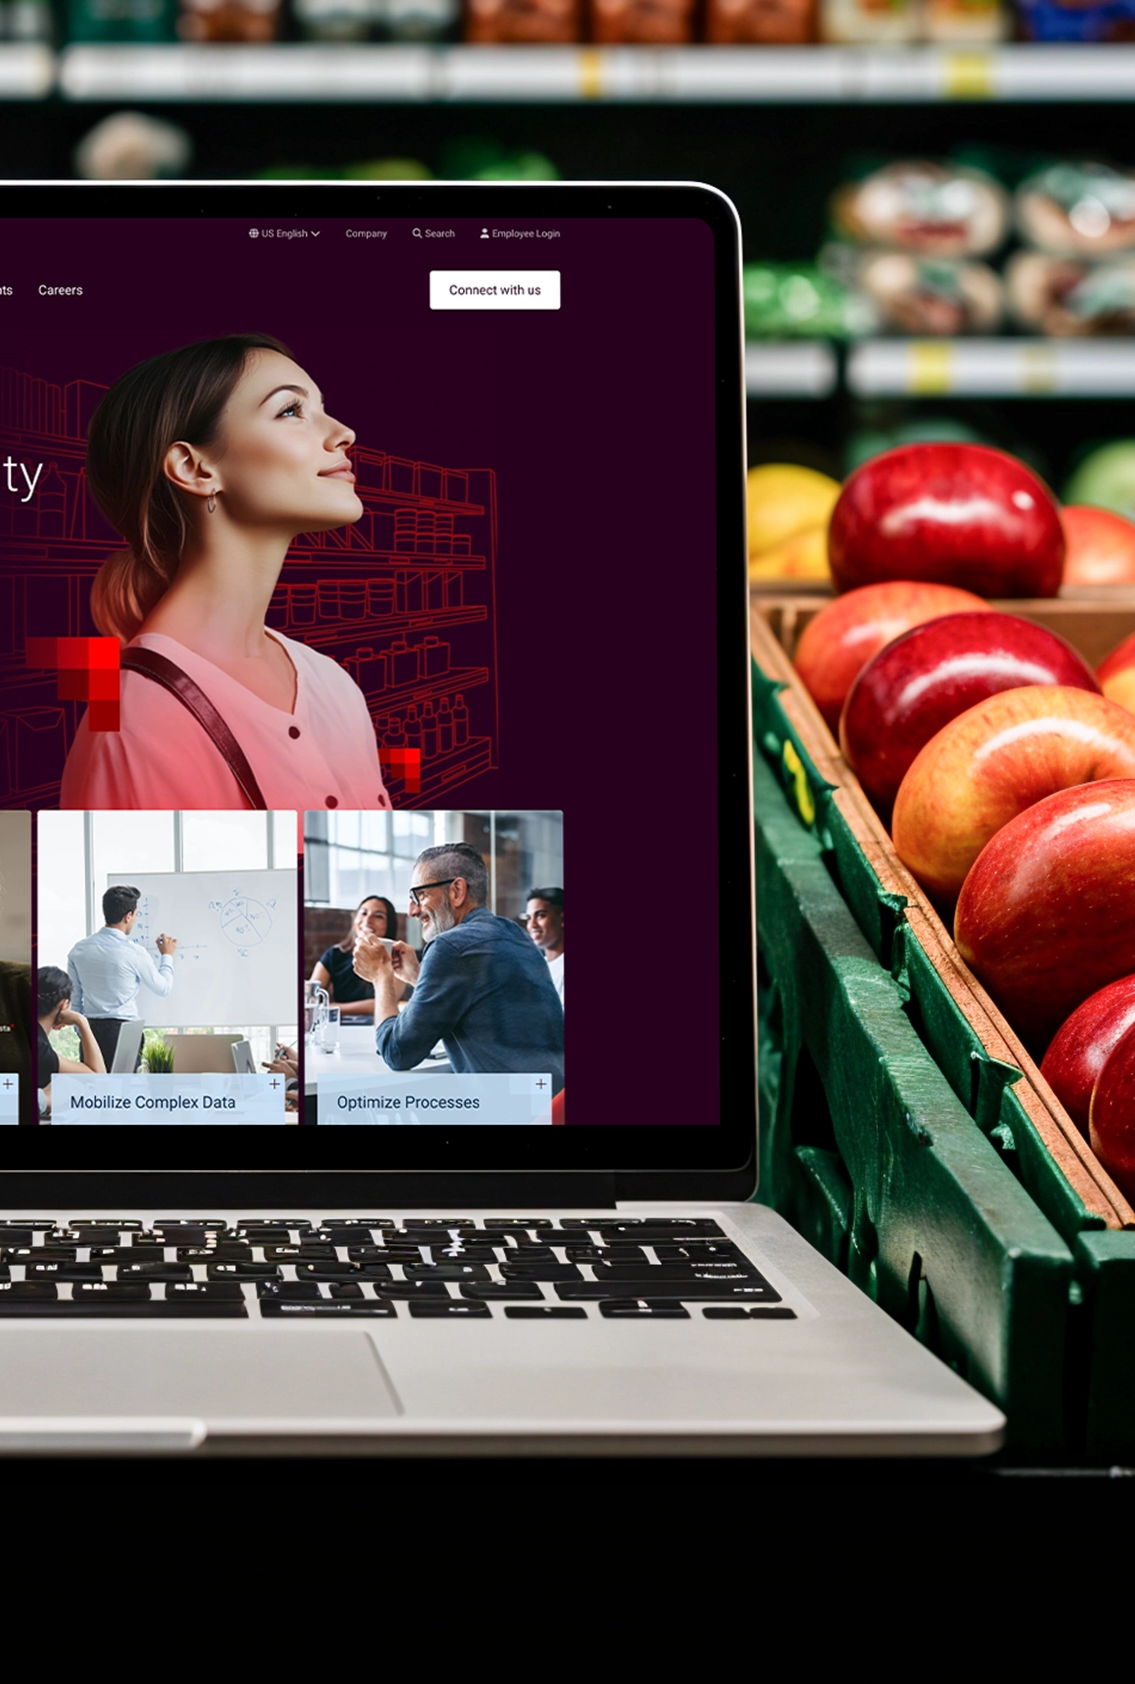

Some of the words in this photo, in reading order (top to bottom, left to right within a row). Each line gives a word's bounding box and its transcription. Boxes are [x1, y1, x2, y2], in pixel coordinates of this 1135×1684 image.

[261, 228, 275, 238] US
[276, 228, 308, 240] English
[345, 228, 388, 240] Company
[424, 228, 456, 238] Search
[492, 228, 535, 240] Employee
[535, 229, 561, 240] Login
[38, 284, 84, 296] Careers
[448, 284, 498, 296] Connect
[499, 284, 525, 296] with
[527, 286, 542, 296] us
[70, 1094, 132, 1109] Mobilize
[134, 1095, 199, 1112] Complex
[202, 1095, 236, 1109] Data
[337, 1095, 402, 1112] Optimize
[405, 1095, 480, 1109] Processes
